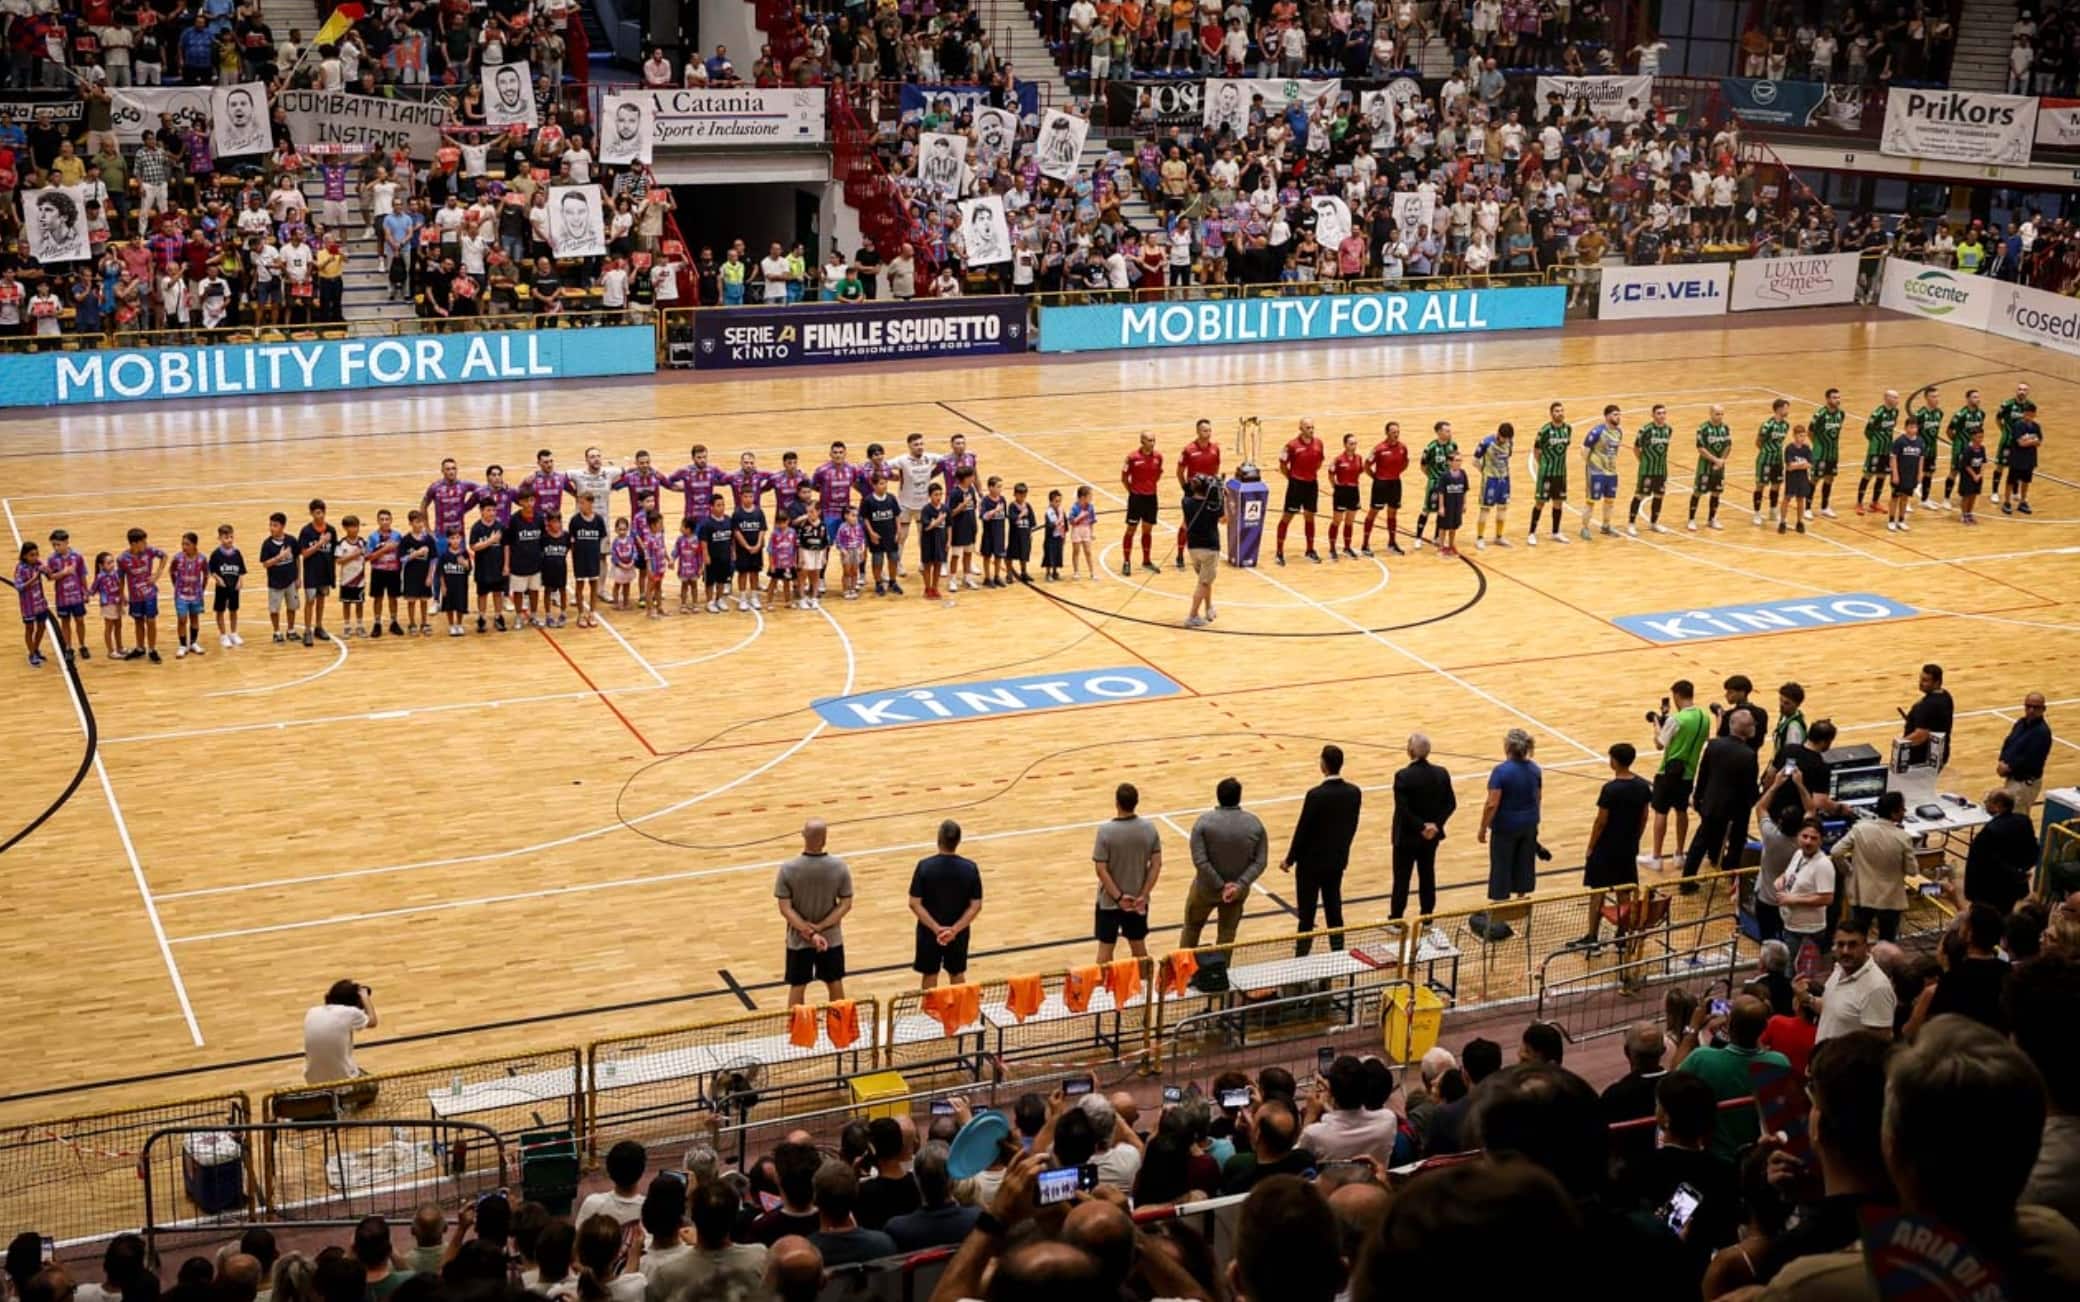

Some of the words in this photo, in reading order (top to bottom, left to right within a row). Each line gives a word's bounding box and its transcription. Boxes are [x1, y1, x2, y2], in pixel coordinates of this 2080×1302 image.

[283, 93, 443, 126] COMBATTIAMO
[673, 92, 764, 112] Catania
[1907, 94, 2015, 125] PriKors
[318, 123, 410, 148] INSIEME
[653, 123, 694, 141] Sport
[697, 122, 705, 136] è
[709, 120, 779, 137] Inclusione
[1764, 260, 1833, 278] LUXURY
[1904, 279, 1969, 304] ecocenter
[1121, 299, 1320, 344] MOBILITY
[1330, 296, 1408, 335] FOR
[1418, 293, 1487, 330] ALL
[724, 326, 774, 344] SERIE
[777, 325, 796, 343] A
[804, 321, 882, 349] FINALE
[886, 314, 1000, 344] SCUDETTO
[833, 346, 894, 356] STAGIONE
[56, 345, 323, 400] MOBILITY
[340, 340, 447, 384] FOR
[460, 334, 552, 378] ALL
